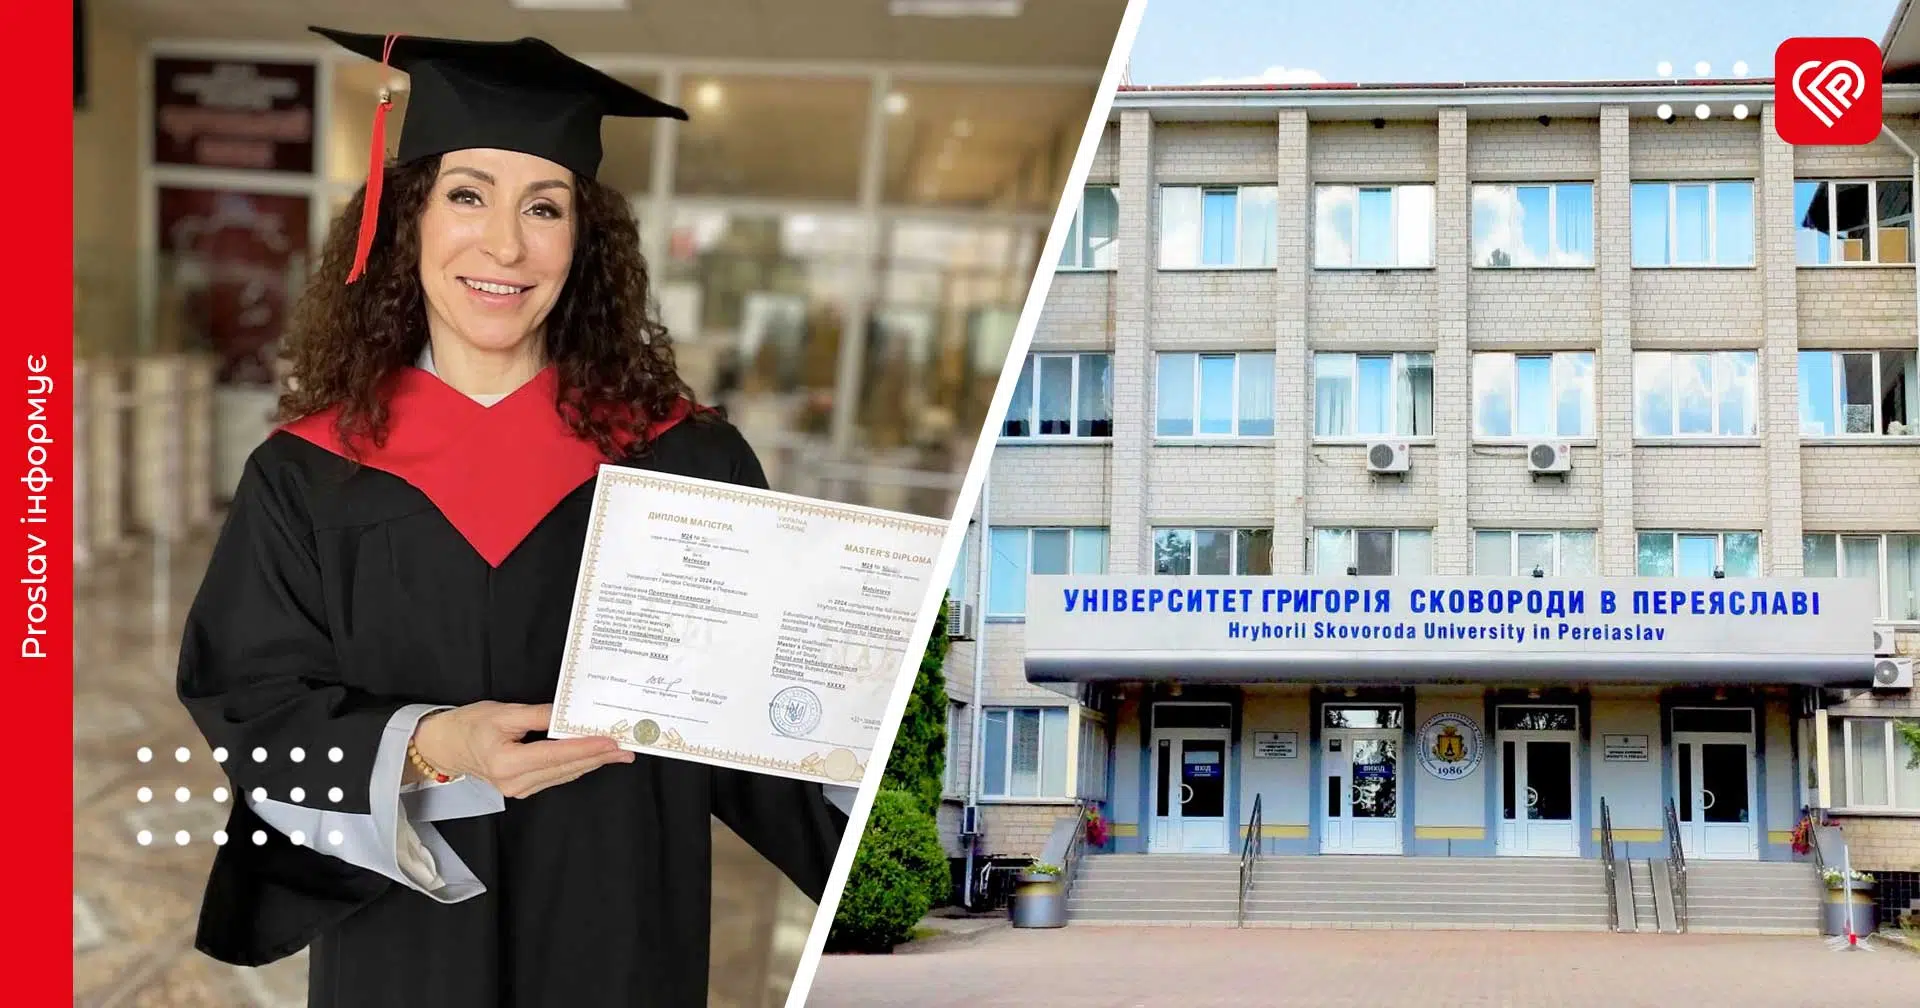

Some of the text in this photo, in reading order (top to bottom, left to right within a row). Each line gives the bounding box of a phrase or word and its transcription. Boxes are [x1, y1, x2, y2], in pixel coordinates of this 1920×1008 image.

[648, 511, 689, 525] ДИПЛОМ
[844, 544, 890, 559] MASTER'S
[1064, 588, 1820, 618] УНІВЕРСИТЕТ ГРИГОРІЯ СКОВОРОДИ В ПЕРЕЯСЛАВІ
[1228, 621, 1666, 643] Hryhorii Skovoroda University in Pereiaslav
[1194, 764, 1212, 774] ВХІД
[1437, 765, 1463, 777] 1986
